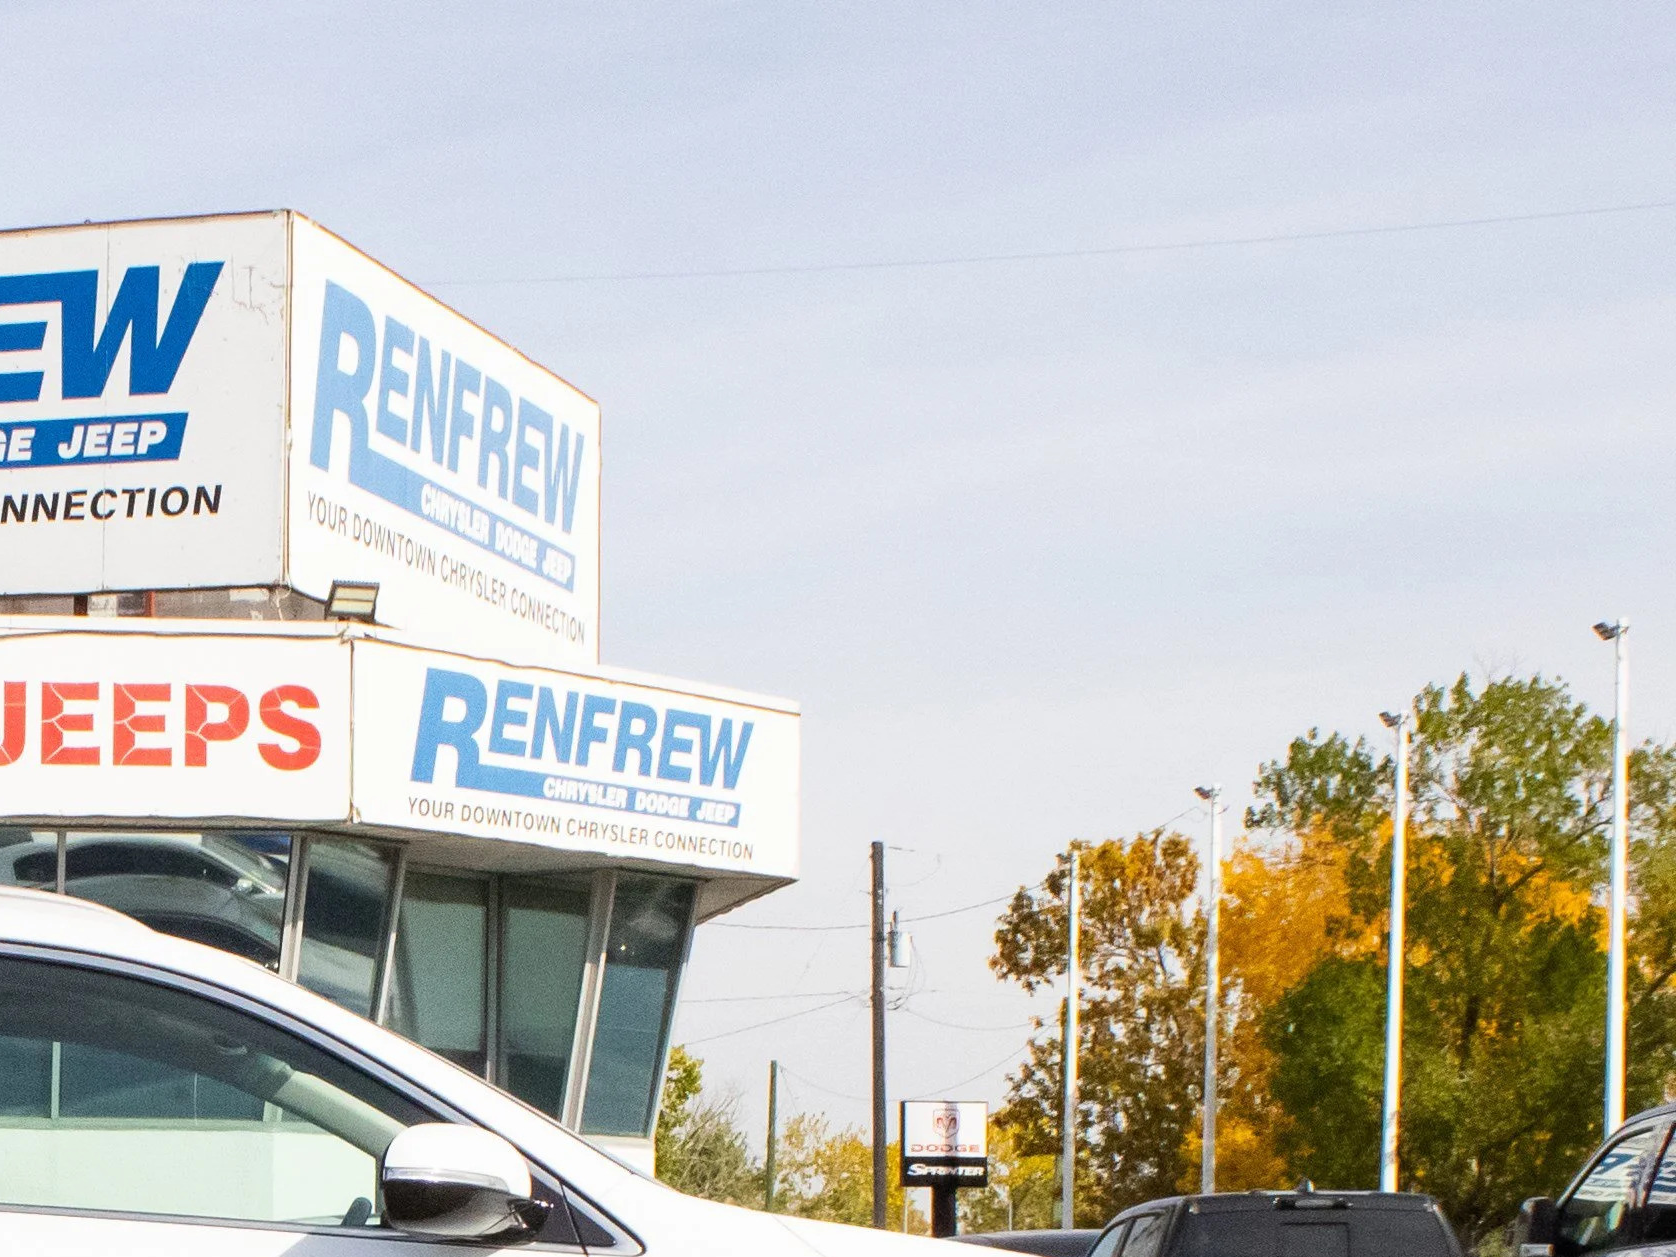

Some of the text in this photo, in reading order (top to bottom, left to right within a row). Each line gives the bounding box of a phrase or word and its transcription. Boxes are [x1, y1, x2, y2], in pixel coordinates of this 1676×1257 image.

[58, 420, 168, 460] JEEP
[309, 278, 586, 536] RENFREW
[307, 490, 585, 645] YOUR DOWNTOWN CHRYSLER CONNECTION
[421, 484, 572, 584] CHRYSLER DODGE JEEP
[409, 666, 755, 791] RENFREW
[408, 796, 754, 861] YOUR DOWNTOWN CHRYSLER CONNECTION
[542, 776, 737, 825] CHRYSLER DODGE JEEP
[910, 1144, 980, 1153] DODGE
